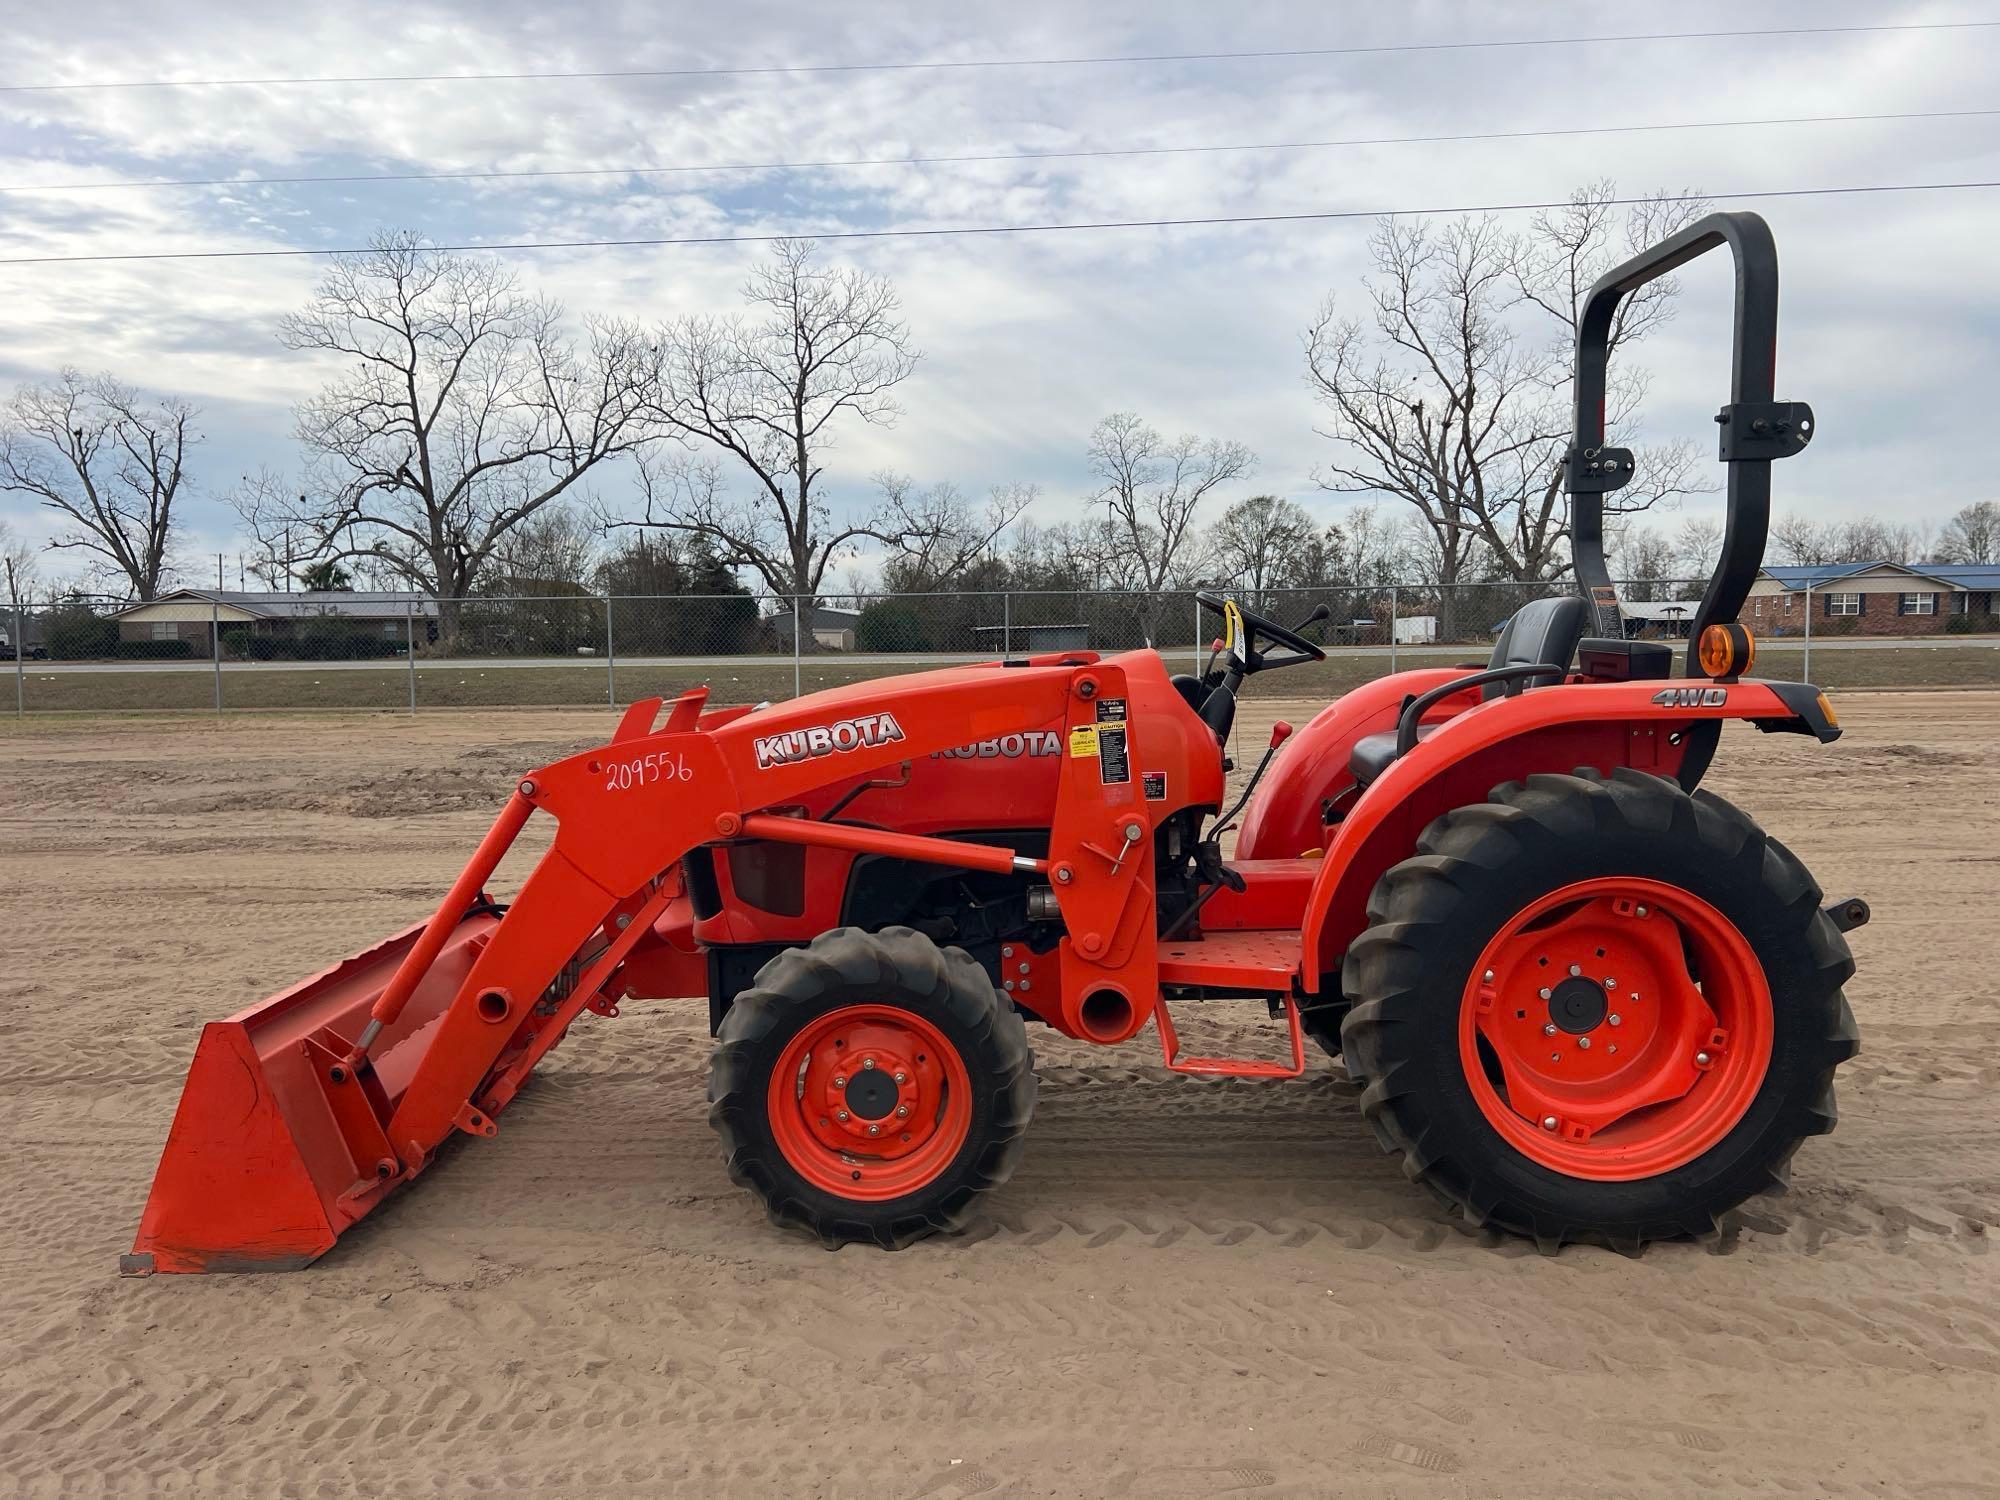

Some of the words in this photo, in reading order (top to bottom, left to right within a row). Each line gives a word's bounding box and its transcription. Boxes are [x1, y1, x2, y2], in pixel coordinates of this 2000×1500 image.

[1651, 688, 1727, 708] 4WD
[755, 712, 906, 769] KUBOTA
[606, 751, 693, 791] 209556
